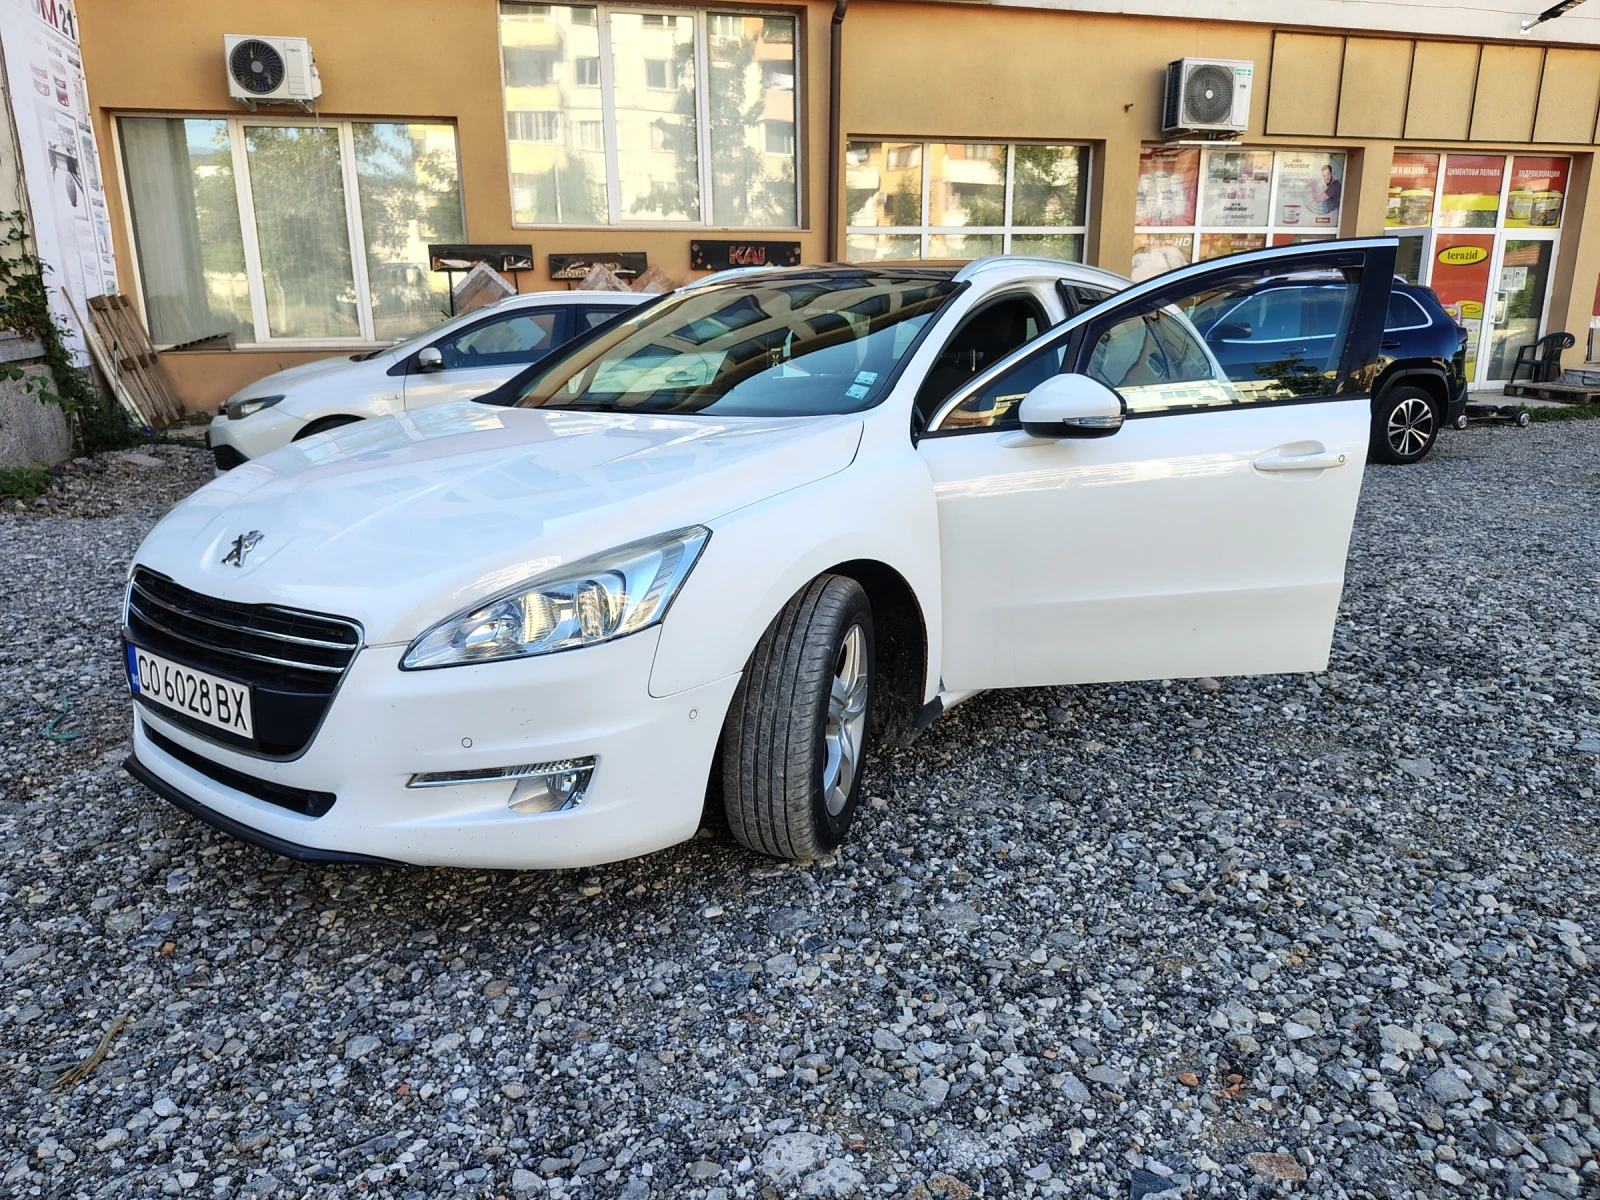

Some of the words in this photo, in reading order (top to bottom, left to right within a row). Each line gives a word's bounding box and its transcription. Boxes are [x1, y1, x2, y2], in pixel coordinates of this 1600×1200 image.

[59, 3, 75, 40] 21
[1447, 167, 1479, 177] ЦИМЕНТОВИ
[1479, 168, 1500, 177] ЛЕПИЛА
[1518, 169, 1561, 178] ХИДРОИЗОЛАЦИИ
[1173, 237, 1191, 247] HD
[729, 246, 765, 265] KAI
[1447, 250, 1478, 260] terazid
[164, 665, 212, 717] 6028
[215, 683, 248, 731] BX
